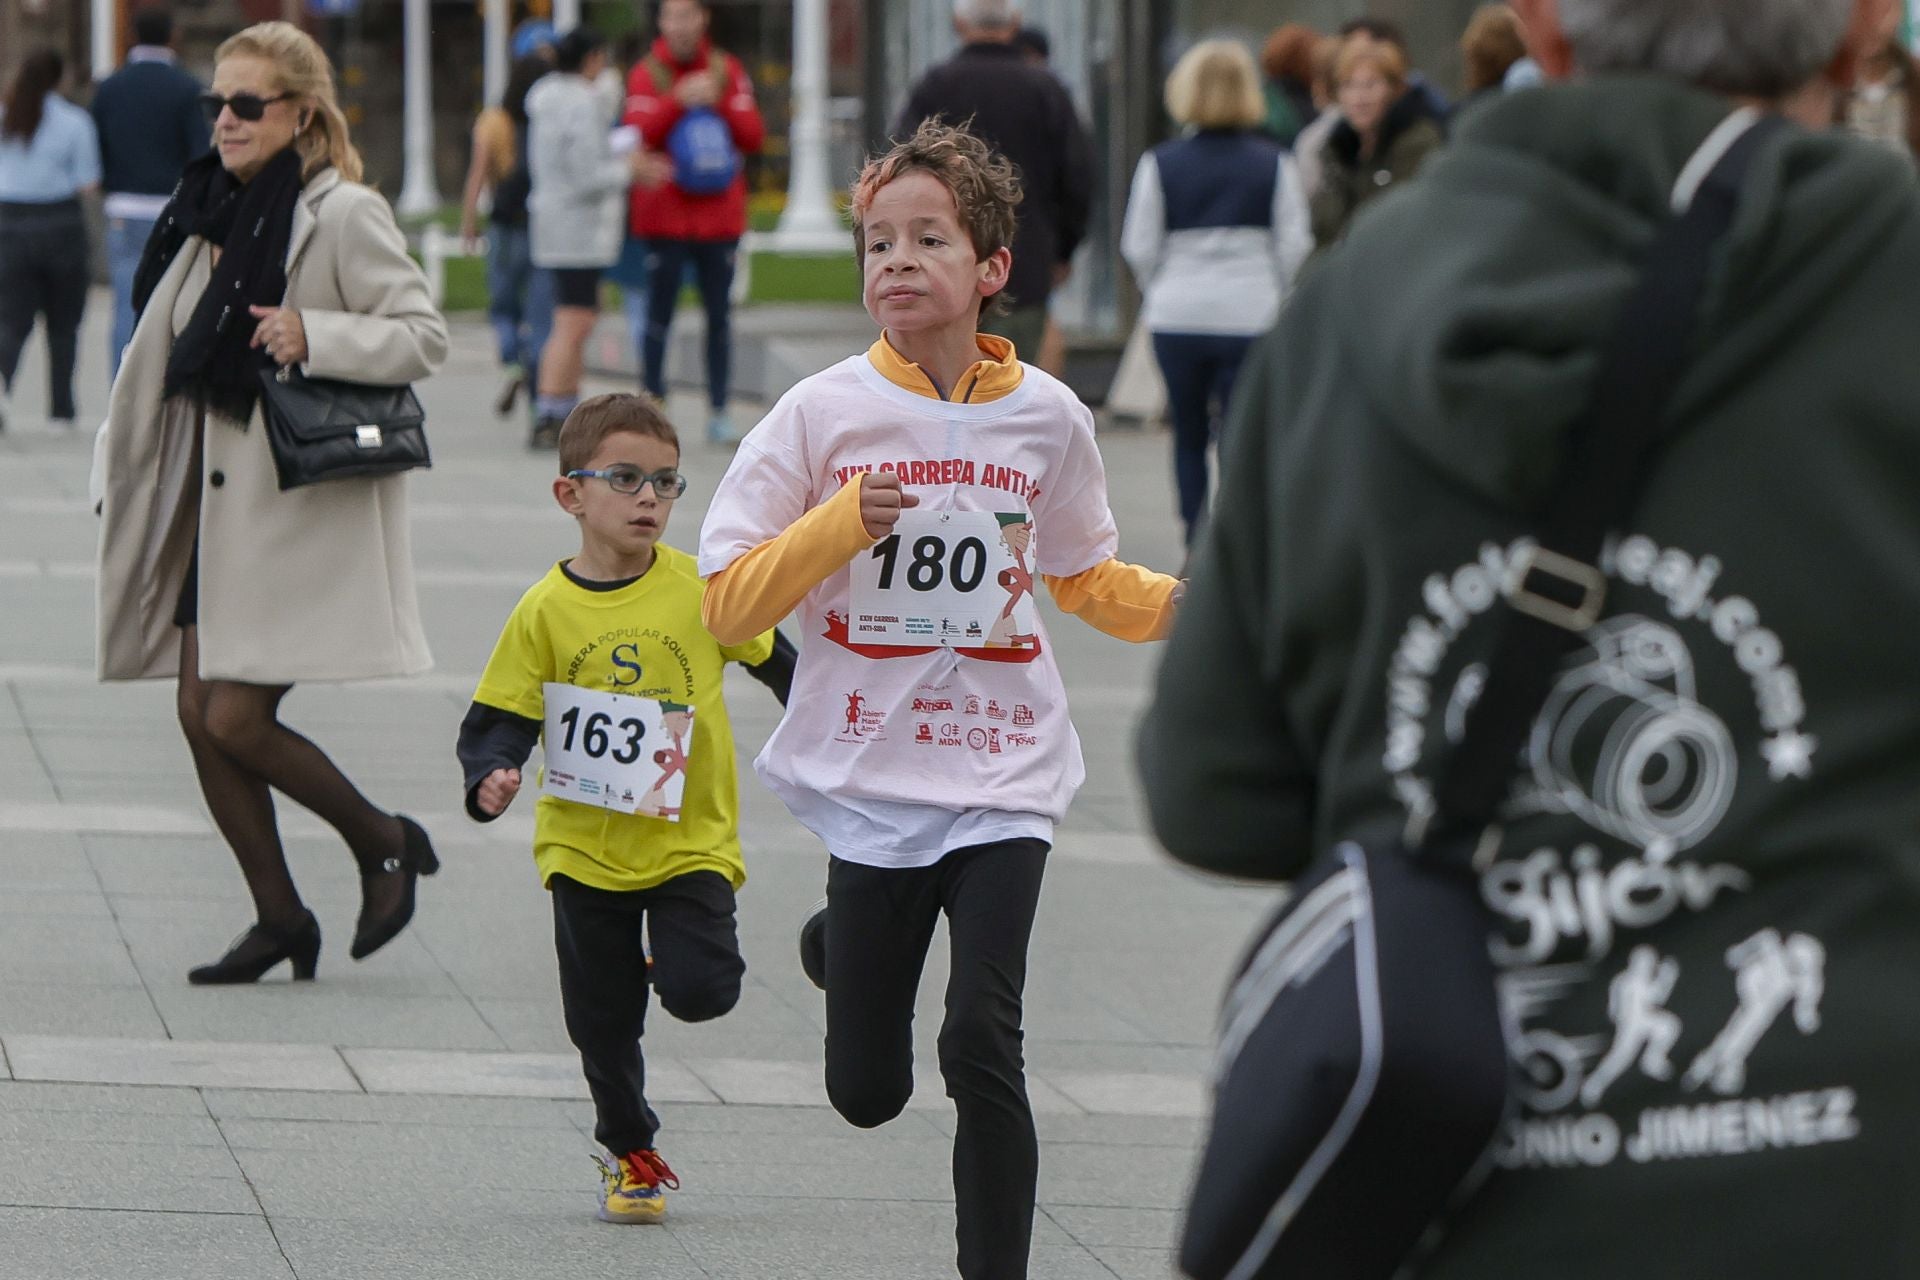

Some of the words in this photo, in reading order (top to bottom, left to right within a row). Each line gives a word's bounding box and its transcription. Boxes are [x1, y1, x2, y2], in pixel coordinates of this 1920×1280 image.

[872, 534, 987, 593] 180
[598, 628, 660, 645] POPULAR
[661, 635, 695, 698] SOLIDARIA
[560, 706, 646, 765] 163
[938, 738, 962, 746] MDN
